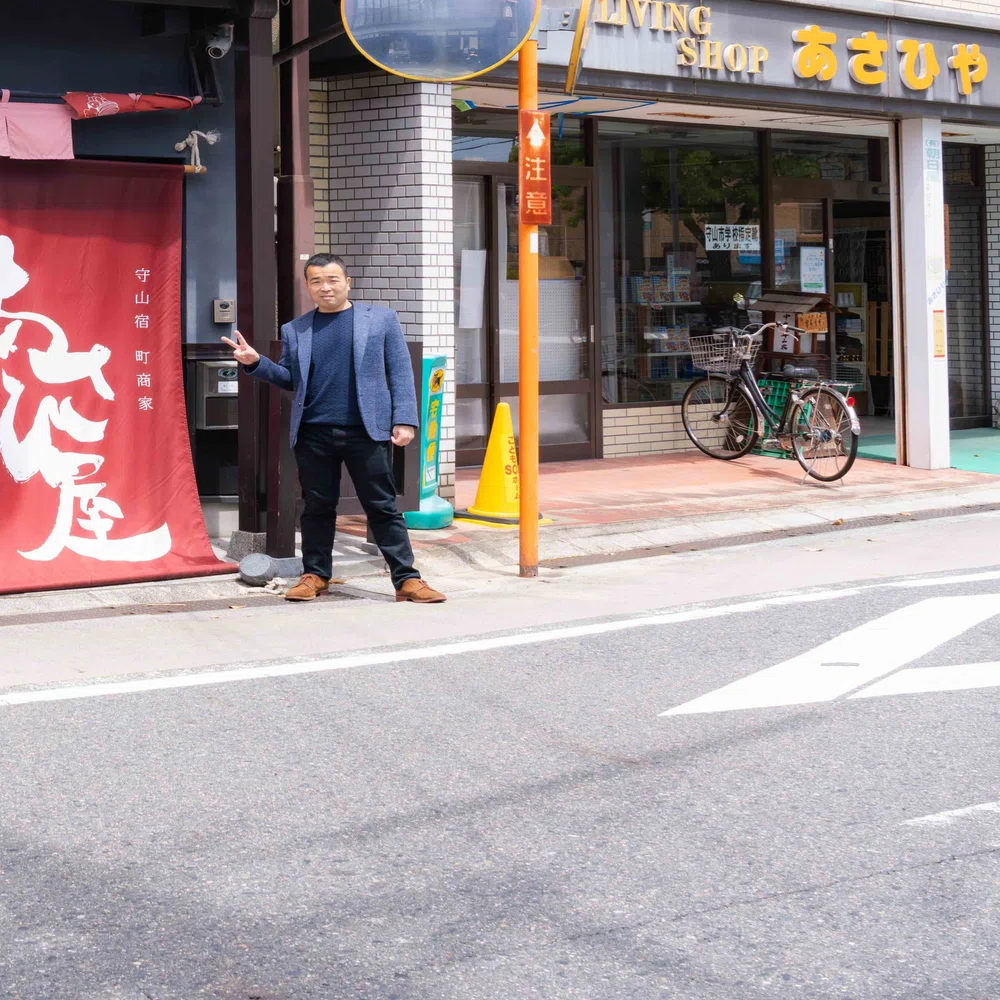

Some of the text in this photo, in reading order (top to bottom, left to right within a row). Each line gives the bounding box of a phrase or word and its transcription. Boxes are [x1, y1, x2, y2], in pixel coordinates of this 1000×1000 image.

[677, 37, 769, 74] SHOP
[792, 24, 988, 95] あさひや
[525, 156, 548, 215] 注意
[134, 267, 154, 412] 守山宿 町商家
